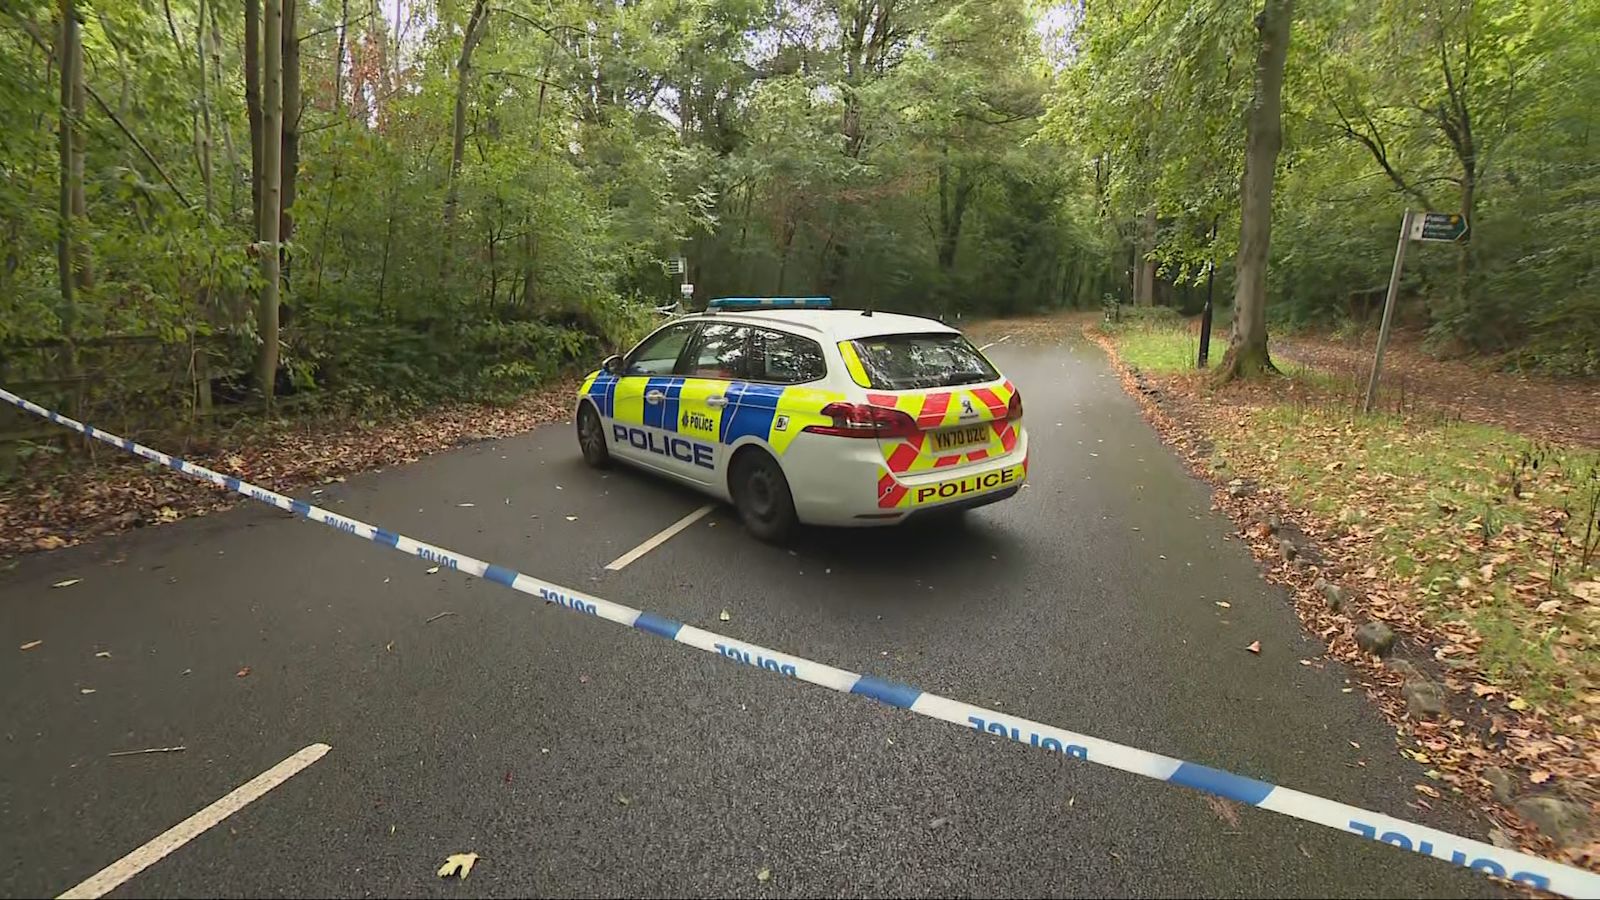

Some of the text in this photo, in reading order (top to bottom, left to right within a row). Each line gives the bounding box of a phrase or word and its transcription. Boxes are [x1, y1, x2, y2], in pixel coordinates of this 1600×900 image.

[690, 416, 713, 431] POLICE
[613, 424, 715, 470] POLICE
[934, 431, 964, 448] YN70
[918, 469, 1013, 502] POLICE
